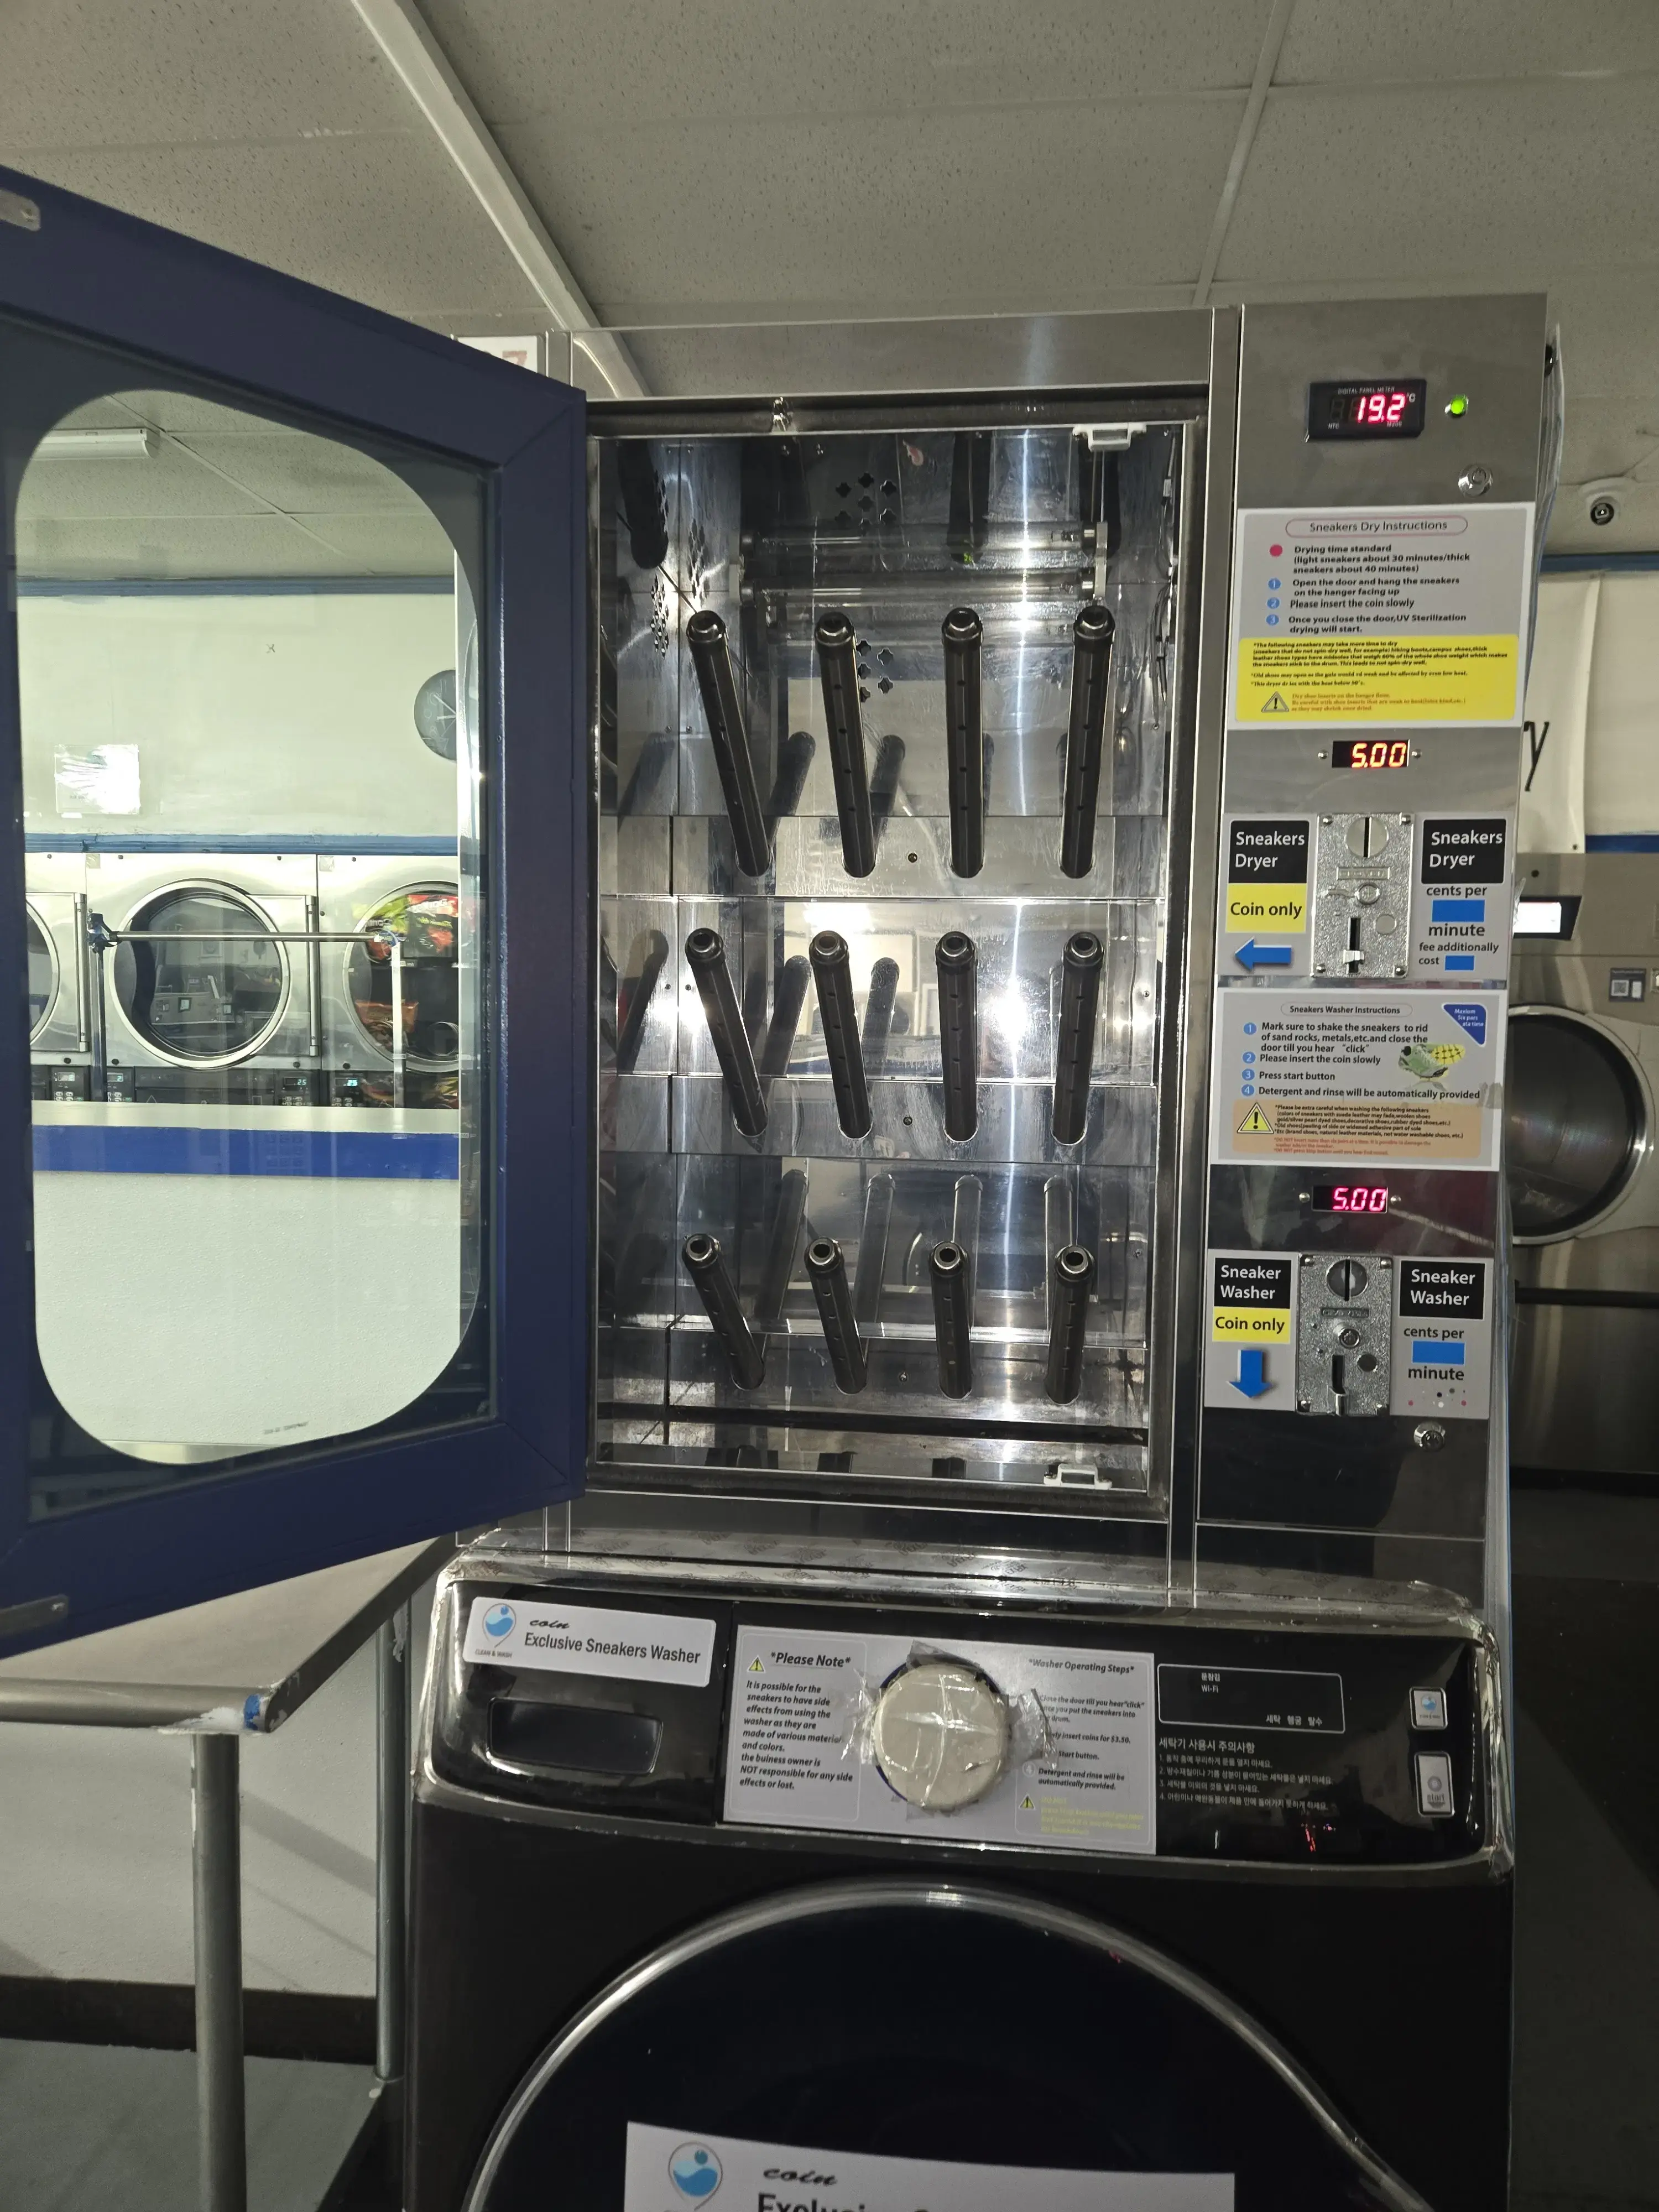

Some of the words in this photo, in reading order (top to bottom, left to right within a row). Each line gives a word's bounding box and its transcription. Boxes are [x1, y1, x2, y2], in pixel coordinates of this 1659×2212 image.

[1357, 393, 1406, 424] 19.2
[1310, 521, 1358, 531] Sneakers
[1360, 521, 1380, 533] Dry
[1383, 521, 1447, 530] Instructions
[1294, 546, 1326, 555] Drying
[1293, 555, 1318, 565] (light
[1405, 553, 1469, 561] minutes/thick
[1292, 579, 1317, 588] Open
[1377, 577, 1401, 586] hang
[1324, 588, 1356, 597] hanger
[1358, 587, 1386, 596] facing
[1290, 599, 1318, 608] Please
[1319, 599, 1345, 608] insert
[1348, 598, 1363, 607] the
[1364, 598, 1384, 607] coin
[1386, 598, 1415, 608] slowly
[1352, 743, 1406, 768] 5.00
[1235, 831, 1305, 846] Sneakers
[1431, 830, 1503, 846] Sneakers
[1235, 853, 1278, 871] Dryer
[1429, 853, 1475, 871] Dryer
[1426, 885, 1462, 896] cents
[1464, 886, 1488, 899] per
[1230, 901, 1264, 915] Coin
[1268, 901, 1302, 920] only
[1428, 923, 1485, 936] minute
[1418, 941, 1435, 951] fee
[1437, 942, 1499, 953] additionally
[1418, 956, 1439, 964] cost
[1290, 1005, 1324, 1013] Sneakers
[1261, 1021, 1284, 1030] Mark
[1316, 1022, 1343, 1031] shake
[1344, 1022, 1359, 1031] the
[1360, 1023, 1400, 1032] sneakers
[1415, 1023, 1428, 1032] rid
[1261, 1032, 1271, 1041] of
[1271, 1032, 1293, 1041] sand
[1294, 1032, 1320, 1042] rocks,
[1387, 1034, 1411, 1043] close
[1412, 1034, 1428, 1045] the
[1260, 1042, 1282, 1051] door
[1282, 1043, 1295, 1052] till
[1296, 1045, 1313, 1053] you
[1314, 1043, 1335, 1052] hear
[1259, 1053, 1287, 1062] Please
[1288, 1054, 1314, 1062] insert
[1316, 1054, 1331, 1063] the
[1332, 1055, 1351, 1063] coin
[1352, 1055, 1381, 1066] slowly
[1259, 1071, 1282, 1079] Press
[1305, 1071, 1335, 1080] button
[1258, 1086, 1303, 1097] Detergent
[1303, 1087, 1321, 1095] and
[1322, 1087, 1344, 1096] rinse
[1345, 1087, 1362, 1097] will
[1363, 1088, 1375, 1097] be
[1376, 1089, 1438, 1099] automatically
[1439, 1090, 1480, 1099] provided
[1332, 1187, 1387, 1211] 5.00
[1220, 1264, 1281, 1279] Sneaker
[1411, 1269, 1475, 1284] Sneaker
[1220, 1285, 1276, 1299] Washer
[1410, 1290, 1469, 1305] Washer
[1214, 1316, 1248, 1329] Coin
[1251, 1317, 1285, 1334] only
[1403, 1327, 1438, 1338] cents
[1441, 1329, 1464, 1341] per
[1407, 1366, 1464, 1380] minute
[529, 1619, 570, 1629] coin
[524, 1632, 582, 1651] Exclusive
[585, 1638, 647, 1658] Sneakers
[650, 1645, 701, 1663] Washer
[1064, 1661, 1106, 1674] Operating
[745, 1679, 753, 1689] It
[753, 1680, 760, 1689] is
[760, 1682, 794, 1691] possible
[794, 1683, 807, 1692] for
[807, 1684, 821, 1693] the
[1158, 1737, 1186, 1749] 세탁기
[1188, 1739, 1215, 1751] 사용시
[1218, 1740, 1255, 1754] 주의사항
[740, 1765, 758, 1773] NOT
[758, 1768, 805, 1777] responsible
[806, 1770, 819, 1778] for
[819, 1772, 835, 1782] any
[836, 1772, 853, 1781] side
[739, 1777, 766, 1787] effects
[776, 1779, 794, 1789] lost.
